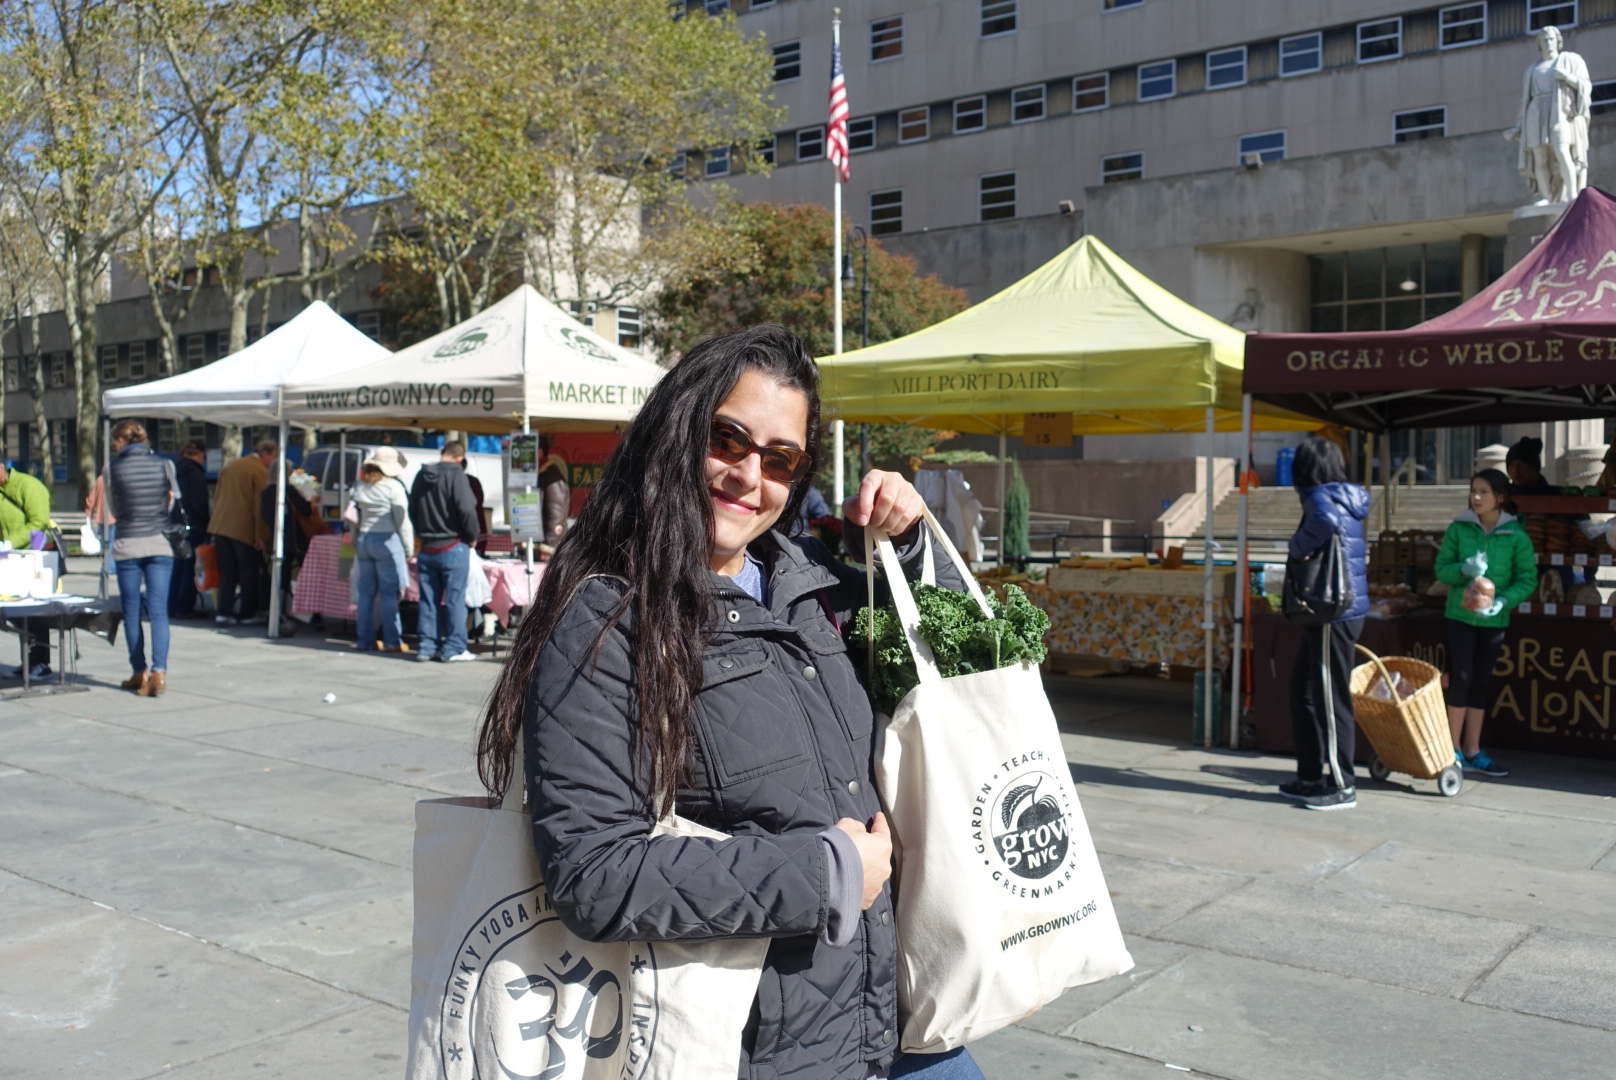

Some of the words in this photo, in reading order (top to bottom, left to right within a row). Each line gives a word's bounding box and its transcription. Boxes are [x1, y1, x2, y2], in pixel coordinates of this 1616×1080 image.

[1442, 338, 1564, 367] WHOLE
[305, 383, 495, 411] www.GrowNYC.org
[549, 381, 628, 405] MARKET
[890, 373, 994, 395] MILLPORT
[997, 370, 1064, 391] DAIRY
[1490, 679, 1610, 732] ALON
[1002, 751, 1044, 772] TEACH
[971, 783, 992, 854] GARDEN
[1001, 814, 1069, 869] grow
[1027, 845, 1058, 869] NYC
[1000, 900, 1097, 951] WWW.GROWNYC.ORG
[450, 945, 482, 1020] FUNKY
[479, 903, 530, 944] YOGA
[623, 1002, 652, 1080] INSPI
